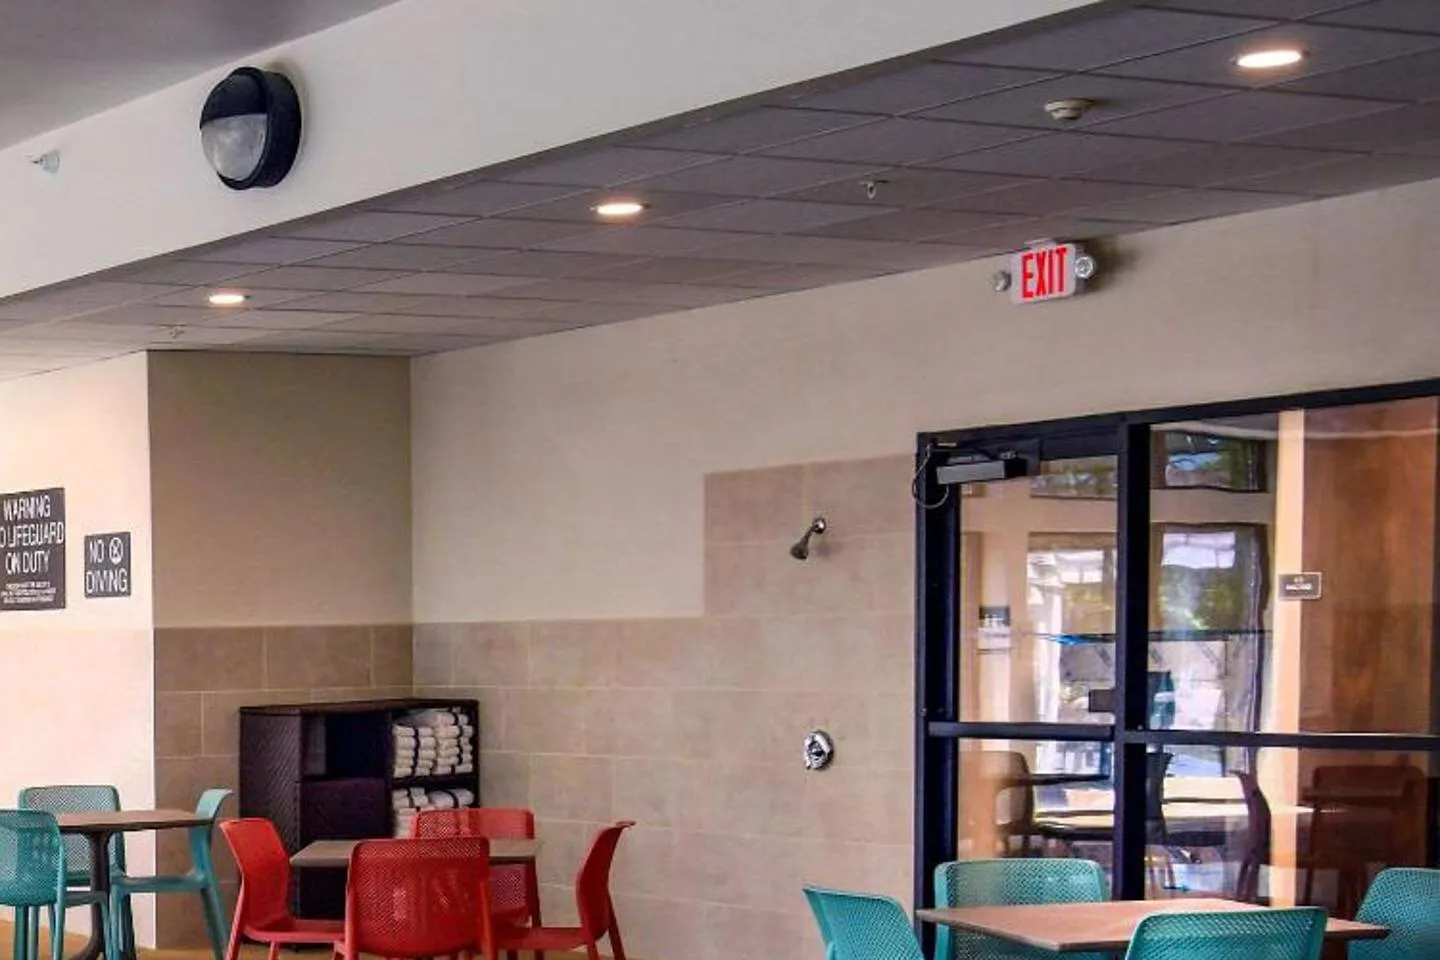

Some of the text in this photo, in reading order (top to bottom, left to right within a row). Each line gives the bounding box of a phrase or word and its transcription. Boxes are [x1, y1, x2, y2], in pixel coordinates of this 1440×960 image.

[1021, 246, 1068, 299] EXIT
[3, 495, 51, 521] WARNING
[8, 521, 64, 548] LIFEGUARD
[5, 550, 50, 574] ON DUTY
[89, 539, 104, 564] NO
[86, 568, 127, 593] DIVING
